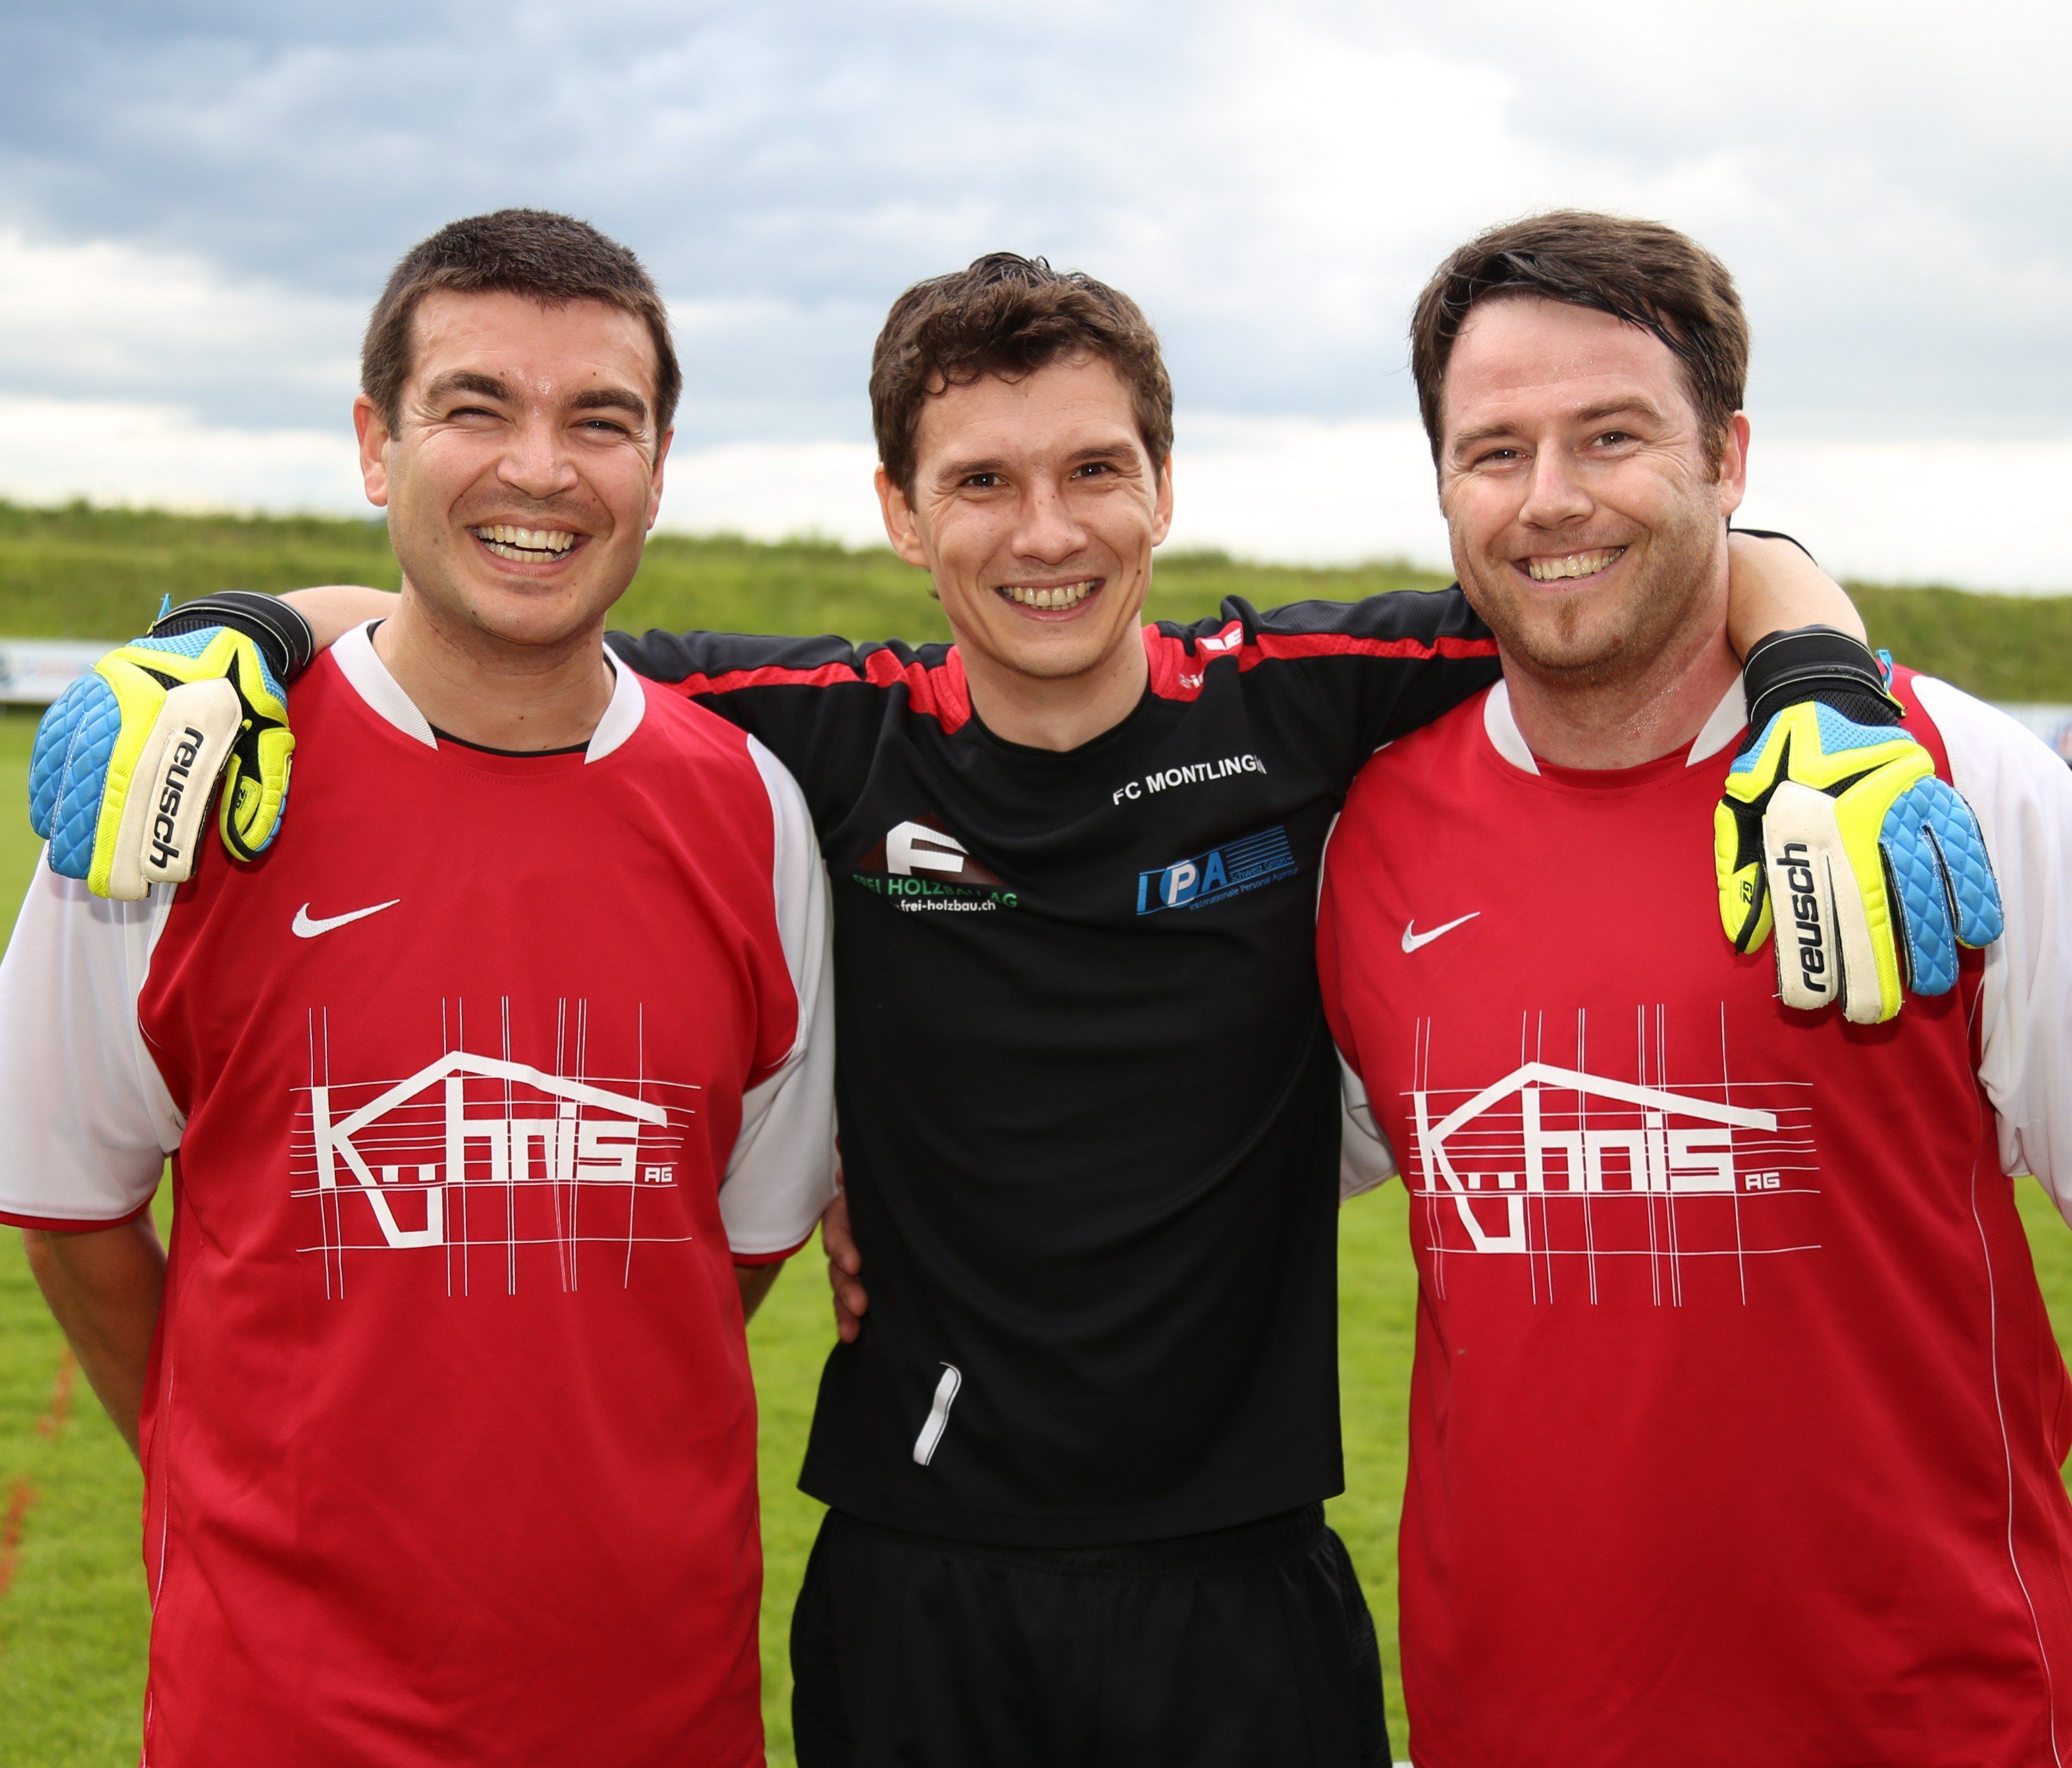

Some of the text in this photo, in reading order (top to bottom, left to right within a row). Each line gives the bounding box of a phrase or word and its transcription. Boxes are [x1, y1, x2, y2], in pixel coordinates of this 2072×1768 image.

[149, 726, 204, 869] reusch
[1112, 781, 1142, 805] FC
[1136, 851, 1228, 913] IPA
[1230, 865, 1263, 882] Schweiz
[1240, 875, 1272, 893] Personal
[991, 892, 1018, 908] AG
[1742, 880, 1753, 906] G2
[1776, 842, 1827, 993] reusch
[644, 1166, 673, 1183] AG
[1745, 1172, 1780, 1190] AG
